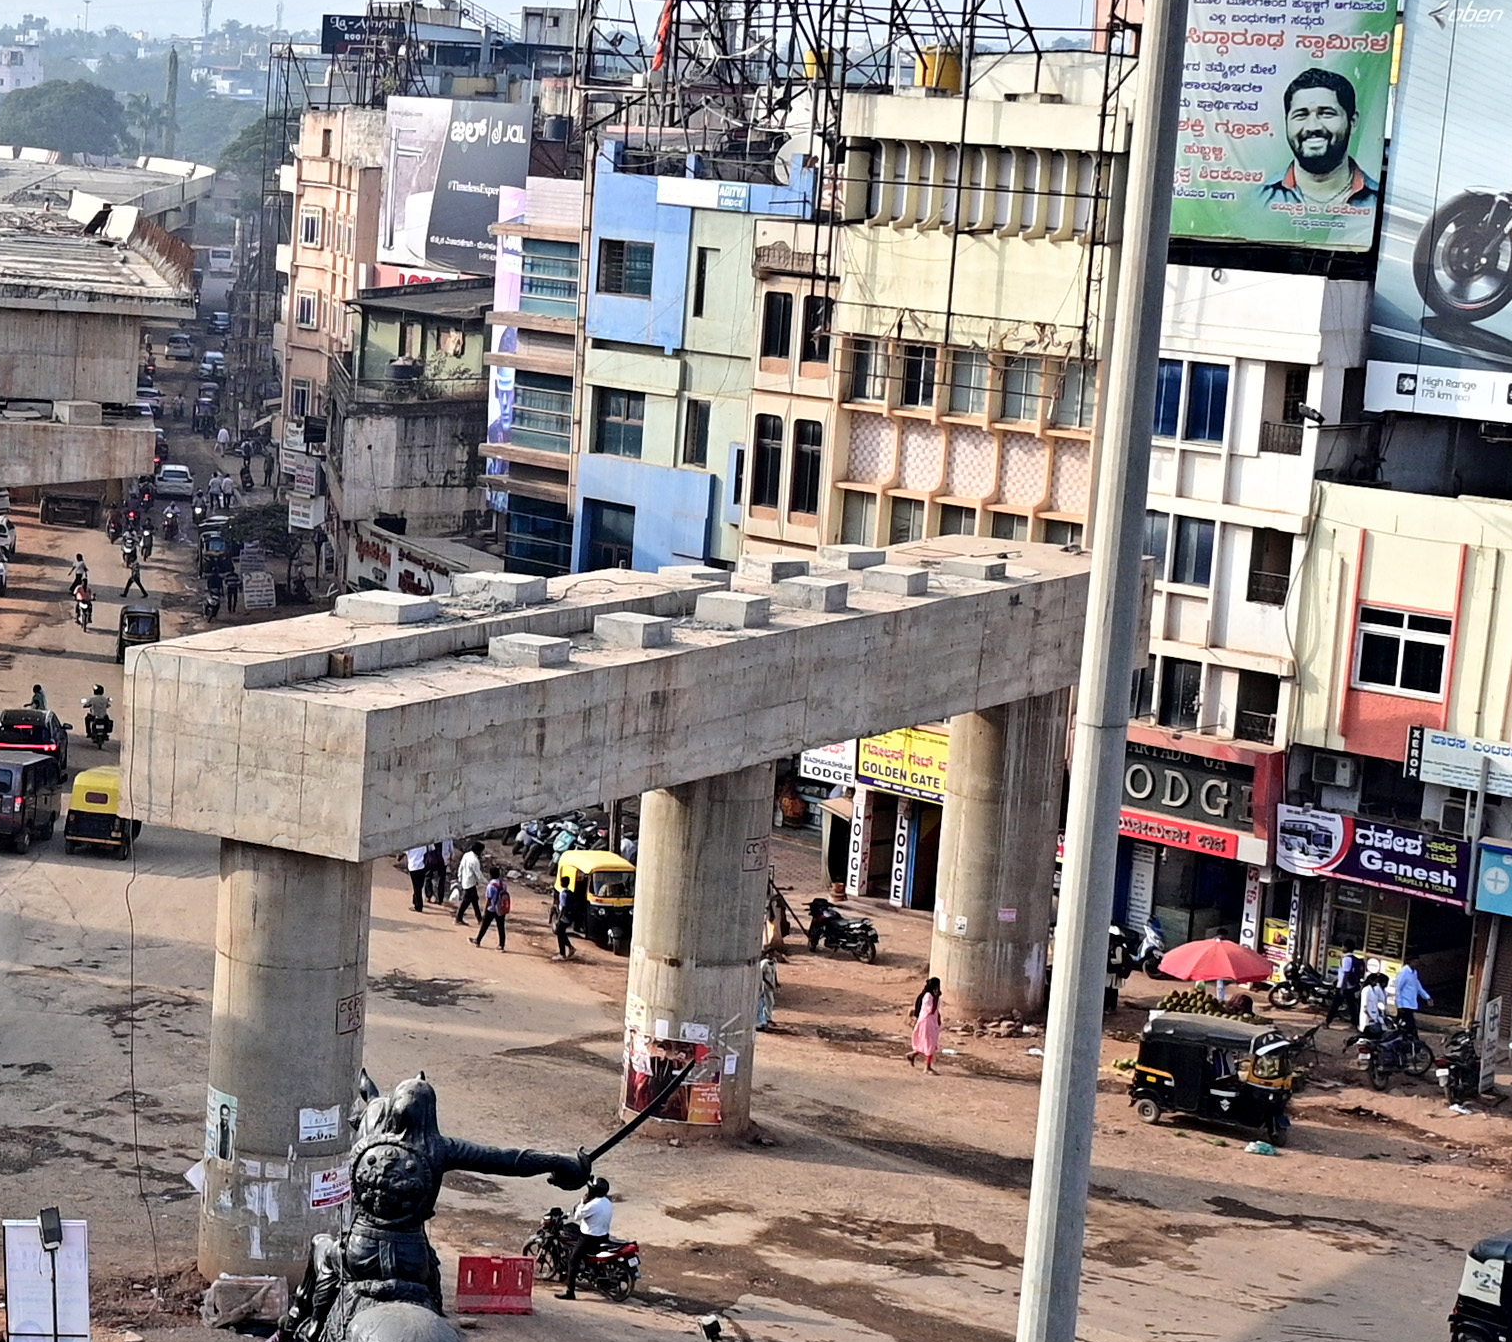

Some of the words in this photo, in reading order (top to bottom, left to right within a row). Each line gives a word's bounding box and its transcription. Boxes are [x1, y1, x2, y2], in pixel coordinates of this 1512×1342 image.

[1448, 0, 1504, 22] oben
[1295, 31, 1390, 58] ಸ್ವಾಮಿಗಳ
[1421, 375, 1443, 390] High
[1445, 377, 1477, 392] Range
[1408, 729, 1422, 777] XEROX
[803, 764, 852, 783] LODGE
[862, 761, 907, 781] GOLDEN
[910, 773, 940, 789] GATE
[850, 806, 861, 887] LODGE
[1354, 824, 1424, 856] ಗಣೇಶ
[893, 816, 905, 899] LODGE
[1360, 850, 1457, 888] Ganesh
